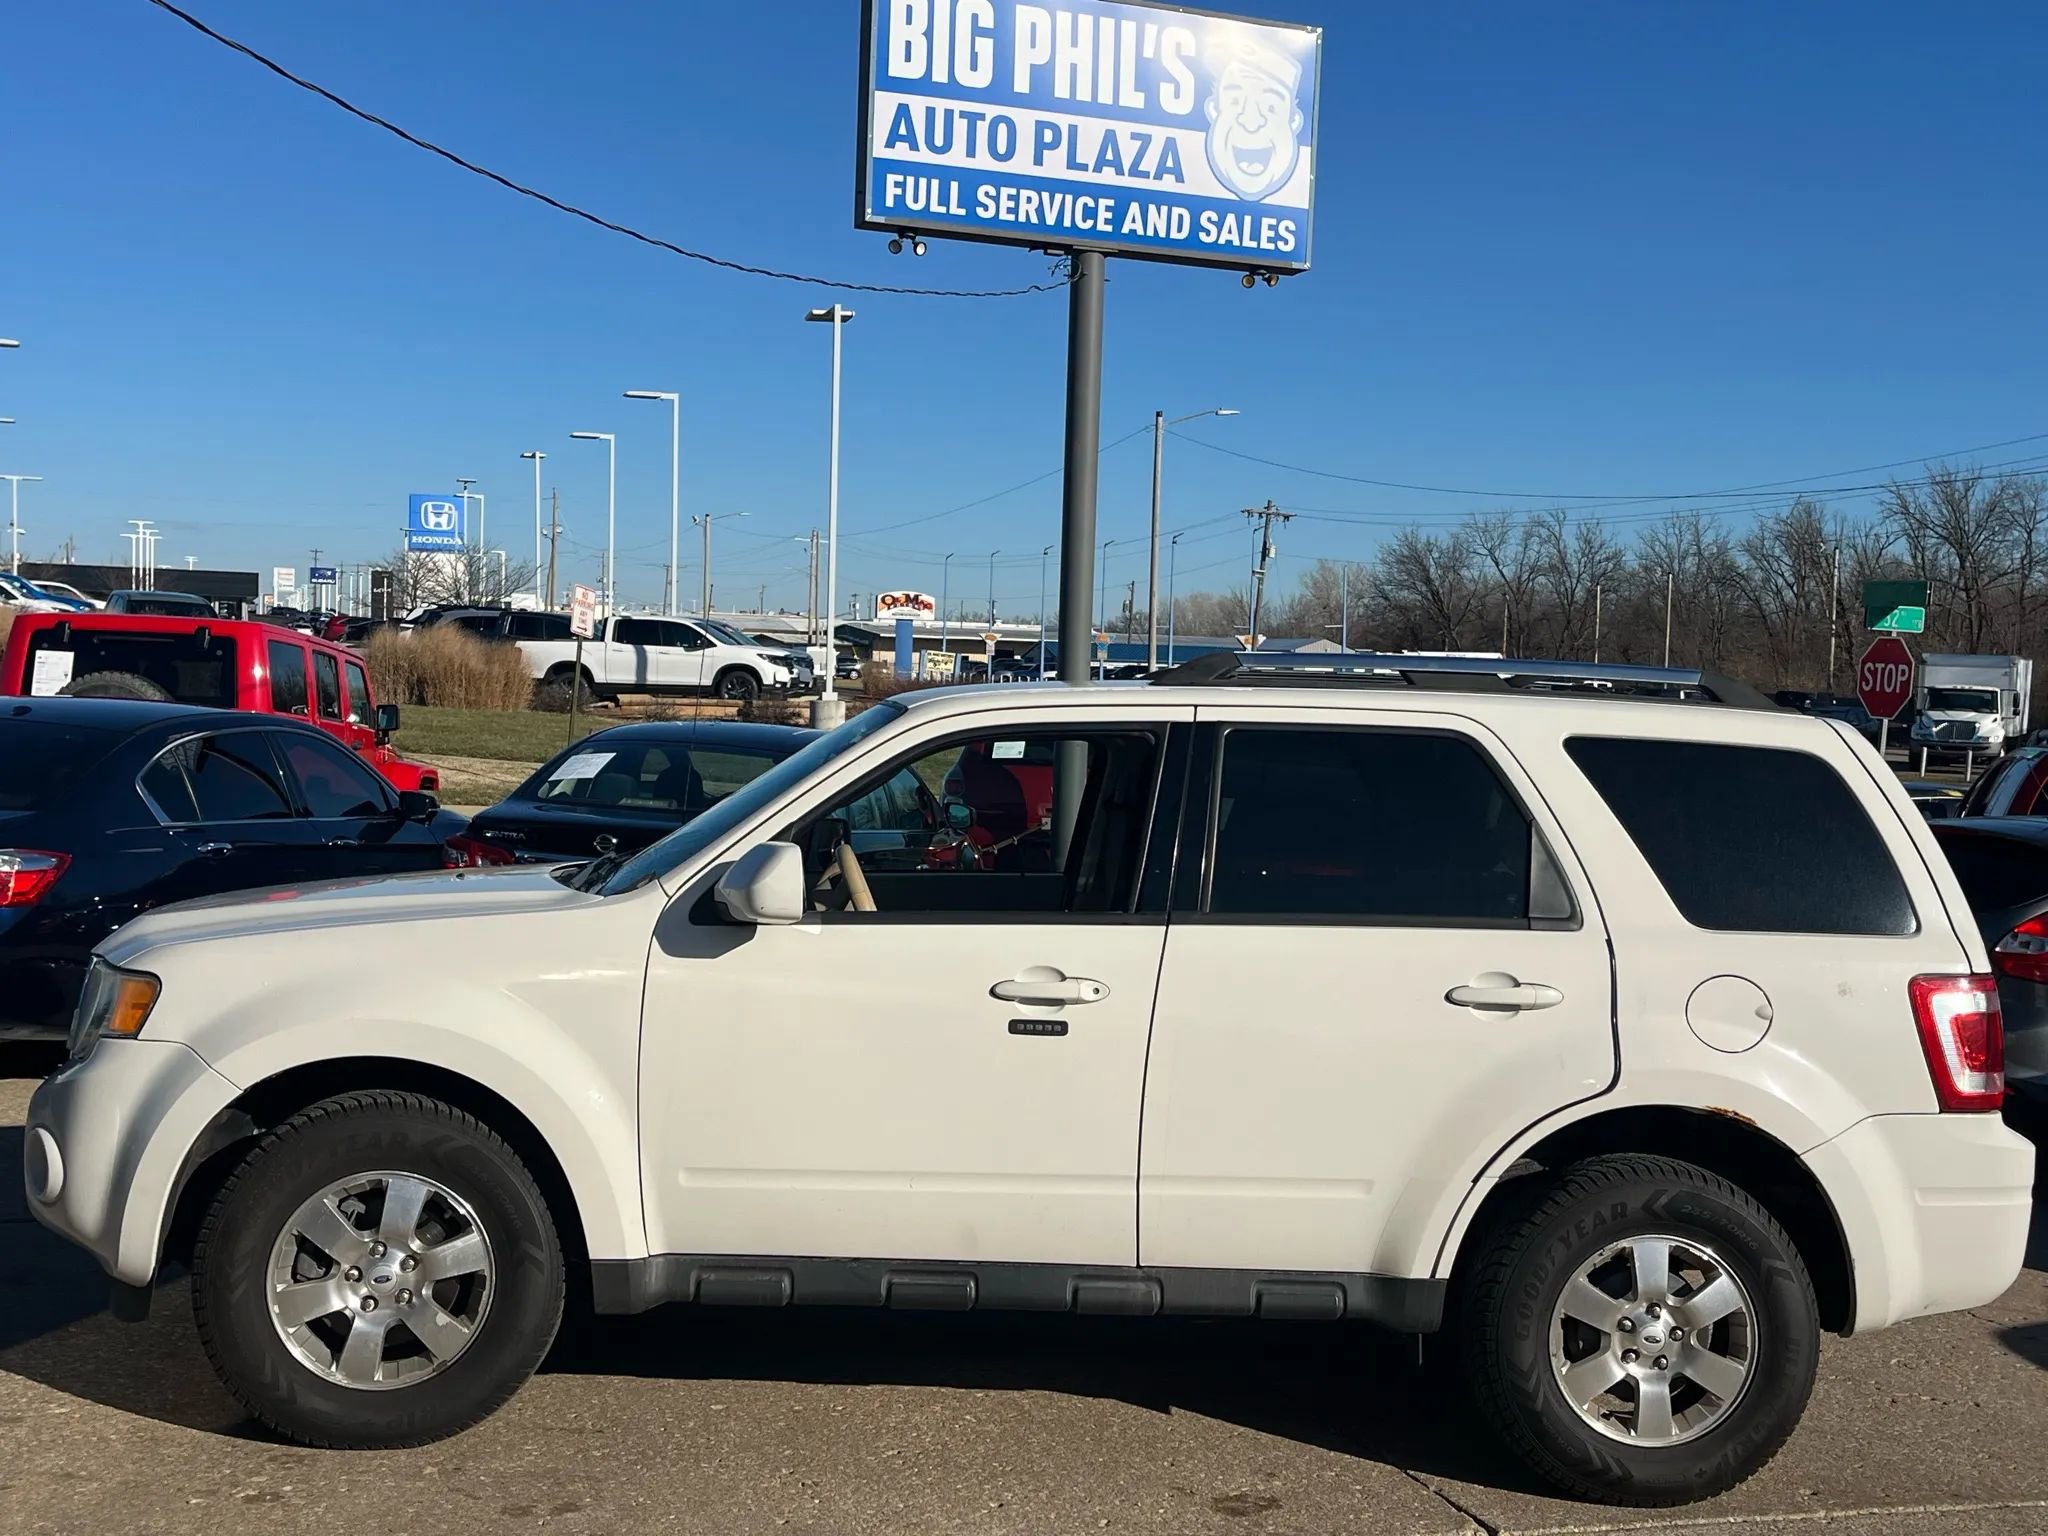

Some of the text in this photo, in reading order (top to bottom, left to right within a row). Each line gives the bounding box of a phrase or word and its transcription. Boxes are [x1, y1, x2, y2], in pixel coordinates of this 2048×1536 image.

[888, 0, 1196, 115] BIG PHIL'S
[884, 103, 1185, 183] AUTO PLAZA
[885, 174, 1296, 252] FULL SERVICE AND SALES
[411, 535, 463, 545] HONDA
[1862, 662, 1909, 693] STOP
